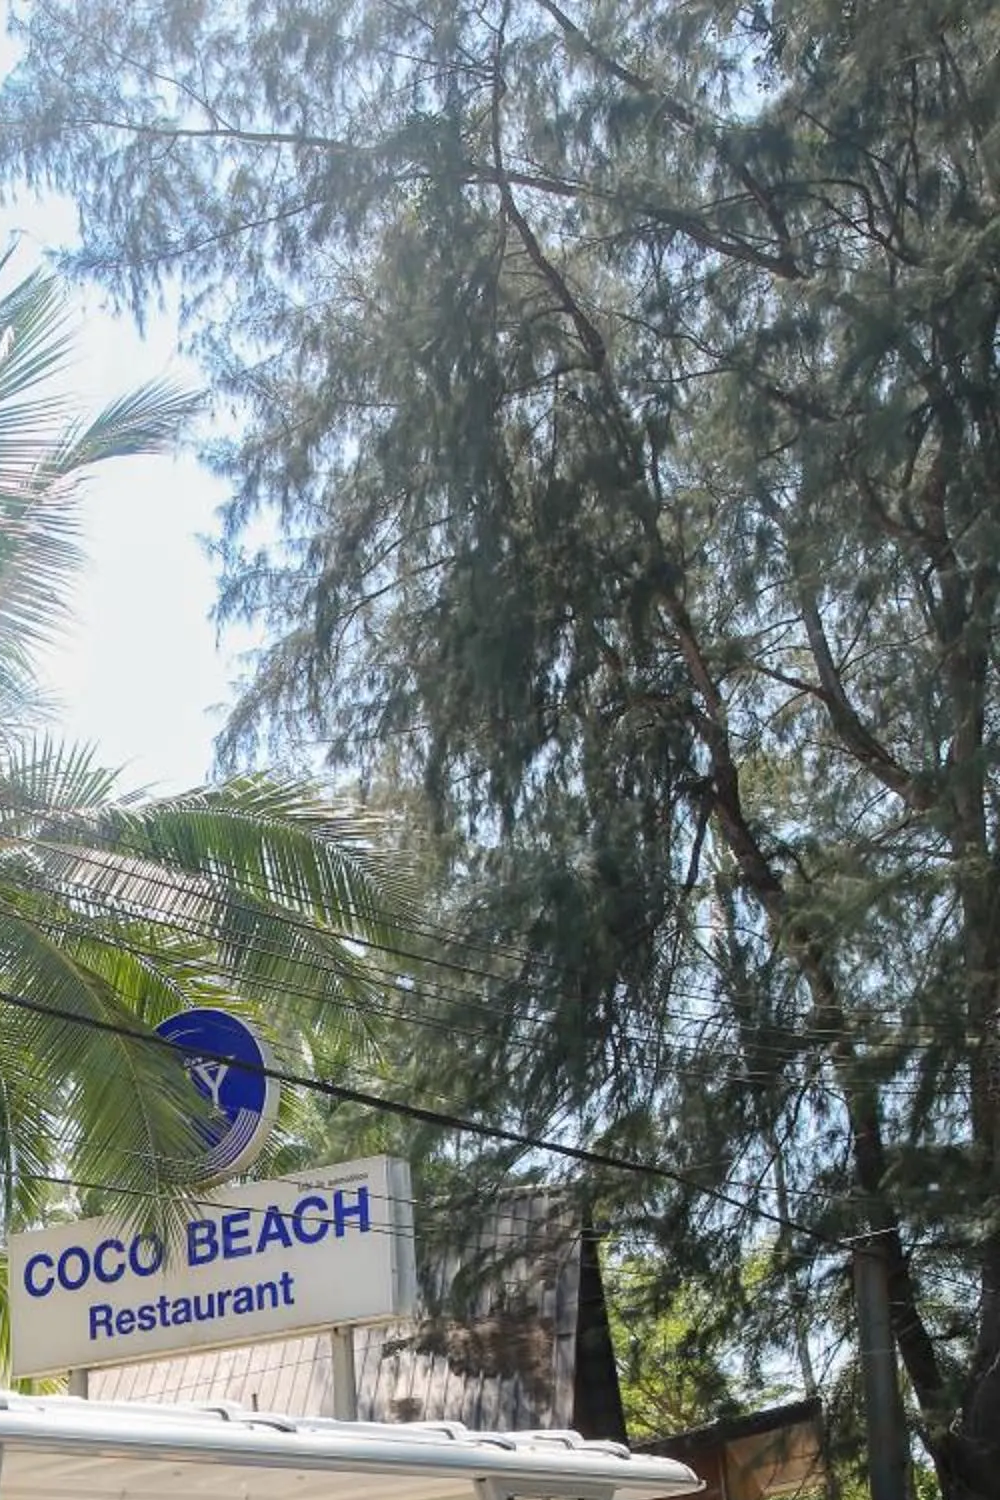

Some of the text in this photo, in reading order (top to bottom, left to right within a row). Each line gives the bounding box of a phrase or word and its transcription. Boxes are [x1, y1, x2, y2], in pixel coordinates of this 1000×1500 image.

[23, 1185, 370, 1298] COCO BEACH
[89, 1271, 295, 1340] Restaurant
